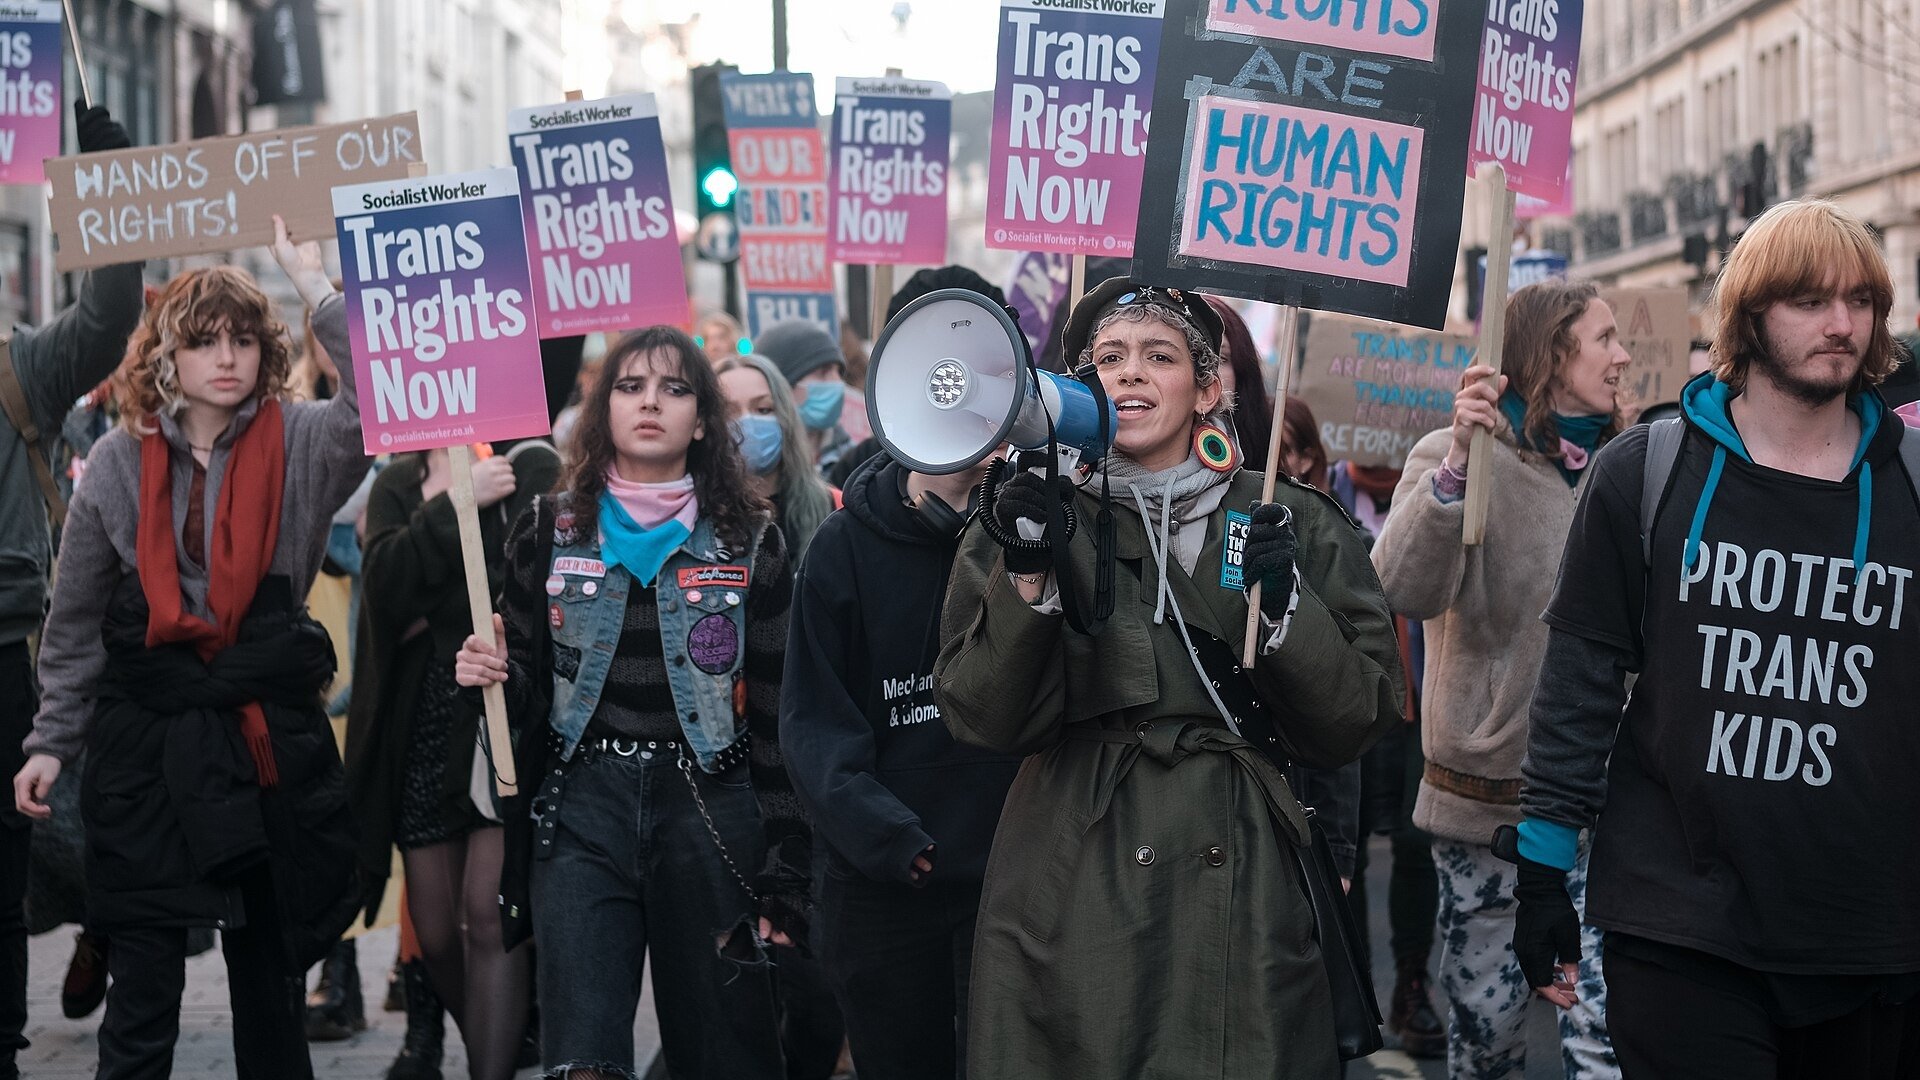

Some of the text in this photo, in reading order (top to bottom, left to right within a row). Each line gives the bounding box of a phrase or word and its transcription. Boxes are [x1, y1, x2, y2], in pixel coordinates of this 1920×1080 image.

[1224, 0, 1429, 37] HTS
[1008, 11, 1141, 84] Trans
[1482, 27, 1571, 112] Rights
[852, 81, 933, 96] Socialist Worker
[1229, 46, 1394, 108] ARE
[529, 104, 633, 129] Socialist Worker
[837, 97, 925, 147] Trans
[1475, 93, 1533, 167] Now
[75, 147, 209, 200] HANDS
[235, 135, 318, 186] OFF
[336, 126, 416, 171] OUR
[515, 133, 634, 190] Trans
[737, 136, 813, 177] OUR
[838, 146, 945, 205] Rights
[1202, 108, 1409, 201] HUMAN
[362, 182, 487, 210] Socialist Worker
[739, 187, 827, 227] GENDER
[1003, 155, 1111, 225] Now
[78, 189, 238, 255] RIGHTS!
[532, 188, 670, 260] Rights
[836, 196, 909, 244] Now
[1008, 231, 1100, 249] Socialist Workers Party
[1195, 179, 1400, 266] RIGHTS
[343, 215, 485, 282] Trans
[746, 241, 826, 283] REFORM
[542, 256, 631, 312] Now
[360, 278, 527, 363] Rights
[1353, 331, 1430, 365] TRANS
[369, 358, 477, 424] Now
[1329, 356, 1365, 378] ARE
[1375, 359, 1420, 386] MORE
[1354, 380, 1417, 408] THAN
[392, 424, 476, 444] socialistworker.co.uk
[1228, 535, 1246, 551] TH
[697, 567, 743, 580] deftones
[1225, 567, 1239, 577] Join
[1678, 538, 1913, 630] PROTECT
[1697, 624, 1874, 708] TRANS
[889, 706, 899, 727] &
[1705, 710, 1837, 787] KIDS
